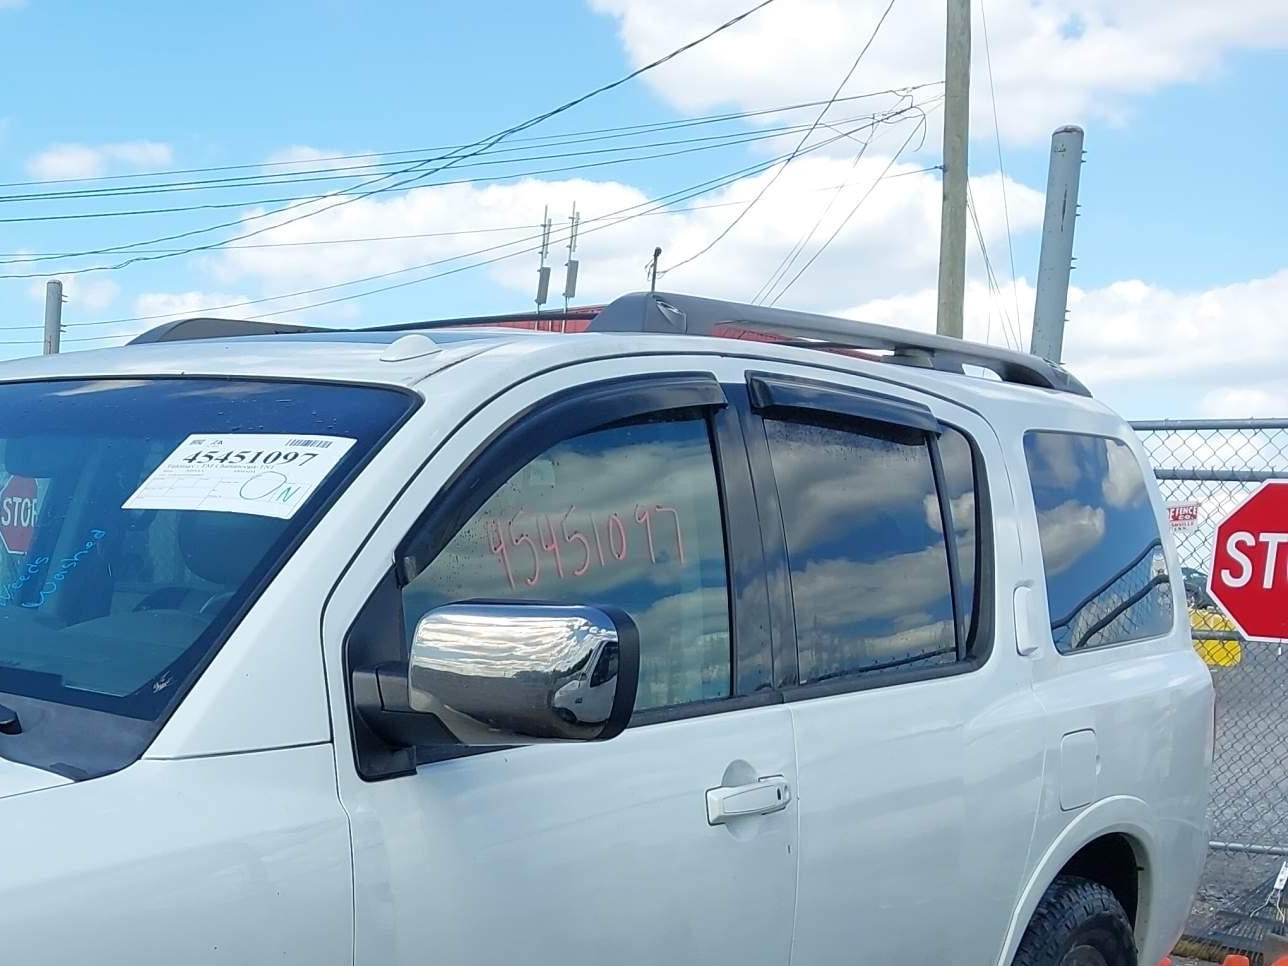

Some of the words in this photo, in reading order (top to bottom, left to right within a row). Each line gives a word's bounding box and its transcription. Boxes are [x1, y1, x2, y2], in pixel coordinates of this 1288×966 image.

[183, 450, 320, 467] 45451097
[486, 503, 686, 591] 45451097
[1220, 531, 1288, 589] ST
